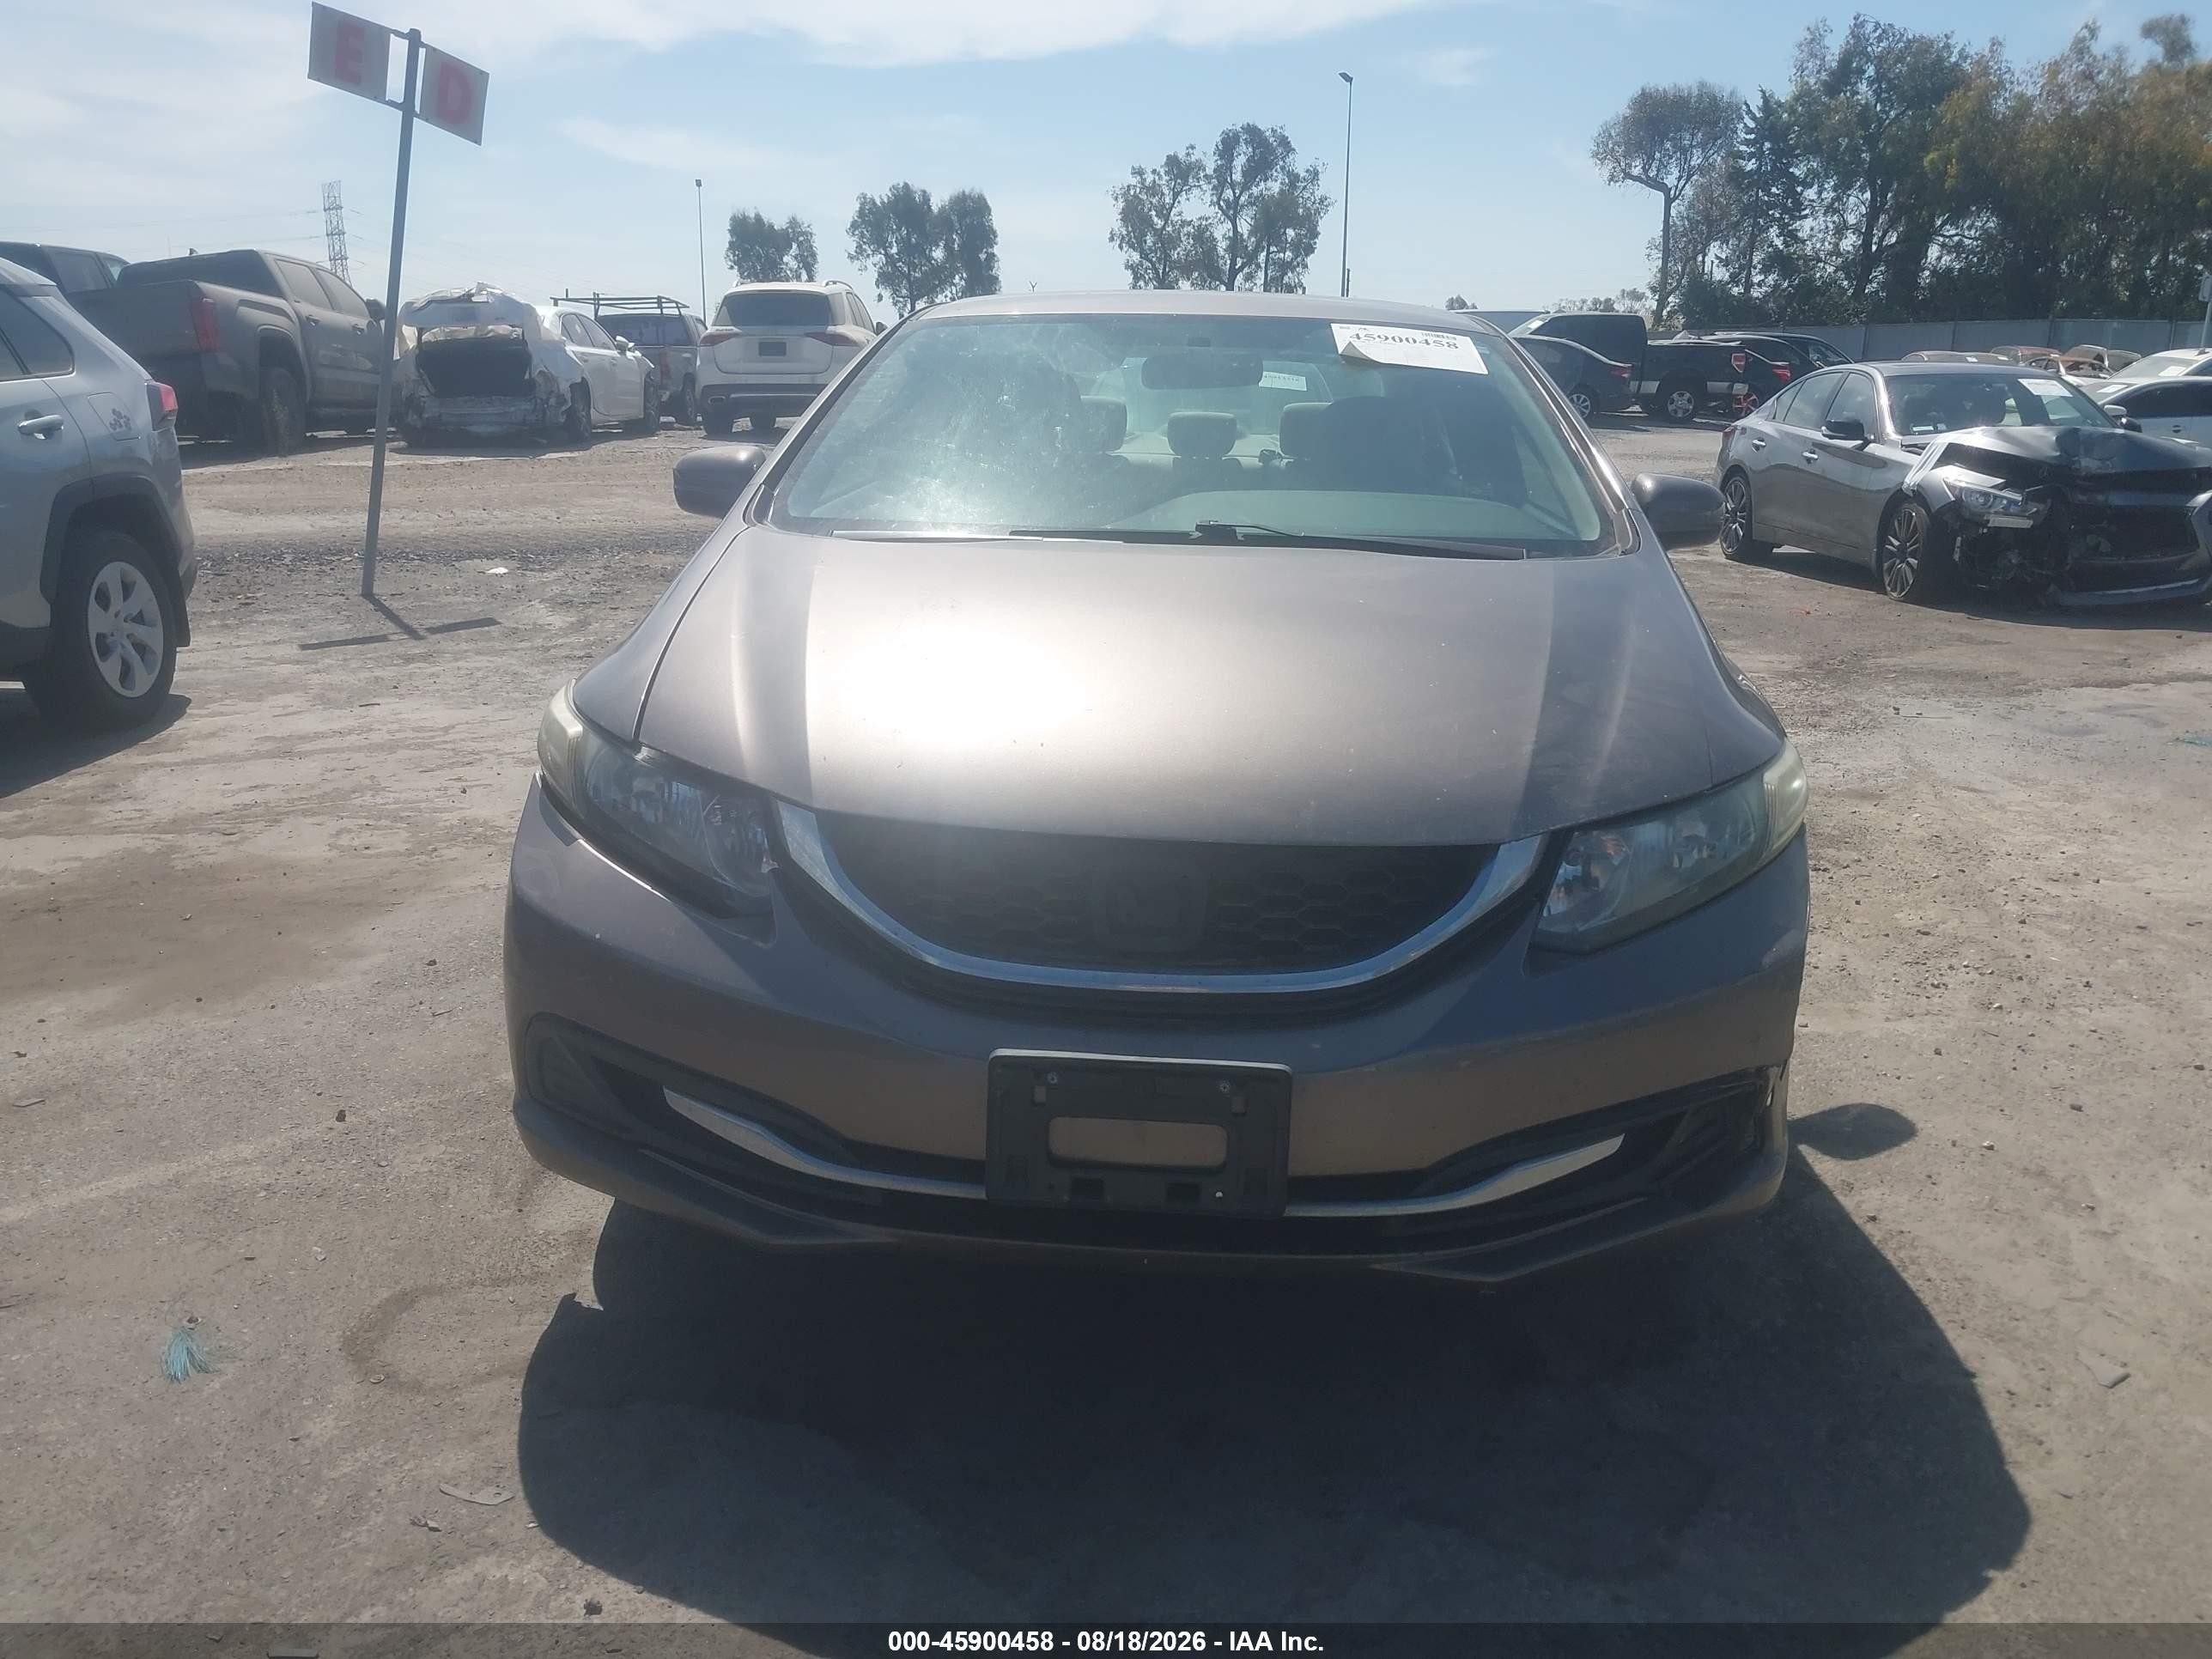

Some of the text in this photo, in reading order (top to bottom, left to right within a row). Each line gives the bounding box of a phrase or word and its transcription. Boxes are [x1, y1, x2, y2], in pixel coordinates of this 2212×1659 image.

[334, 20, 365, 85] E
[437, 61, 472, 125] D
[1349, 332, 1460, 349] 45900458
